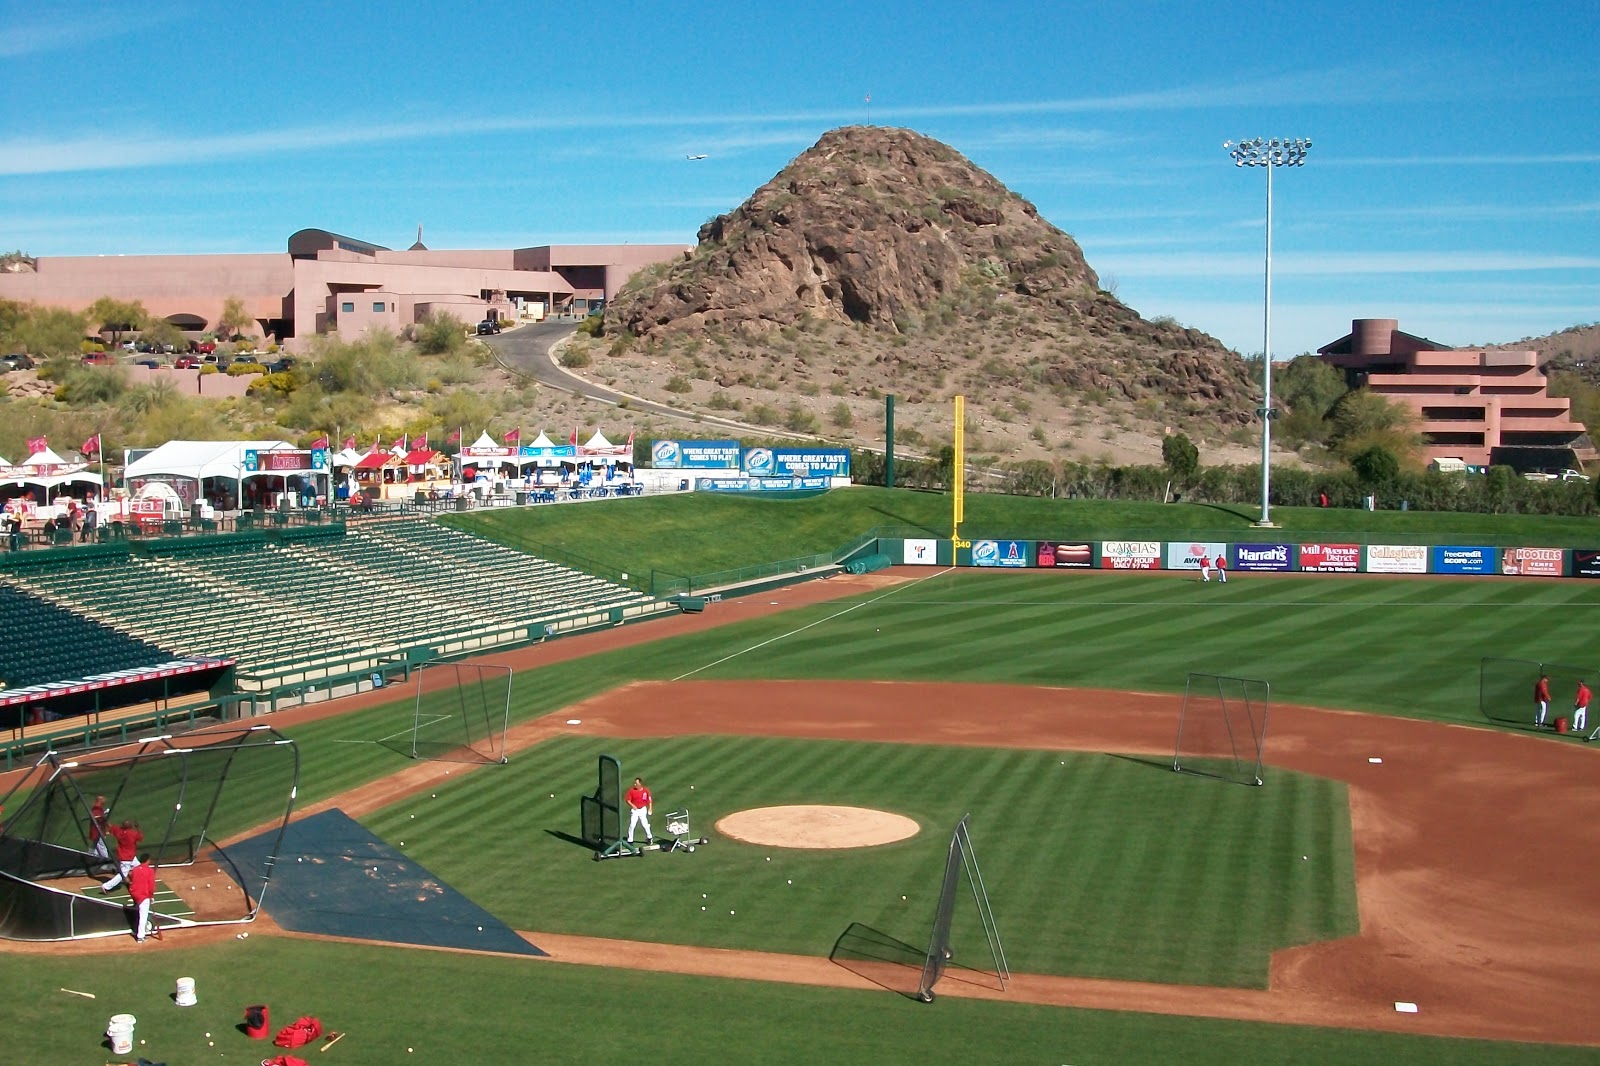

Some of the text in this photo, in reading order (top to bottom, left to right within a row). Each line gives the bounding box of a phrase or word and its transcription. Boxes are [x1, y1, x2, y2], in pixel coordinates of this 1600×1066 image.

[272, 454, 300, 469] ANGELS
[778, 454, 846, 463] WHERE GREAT TASTE
[785, 462, 809, 470] COMES
[1106, 542, 1157, 554] GARCIA'S
[1301, 545, 1358, 555] Mill Avenue
[1327, 554, 1355, 562] District
[1369, 546, 1424, 562] Gallagher's
[1516, 549, 1562, 560] HOOTERS
